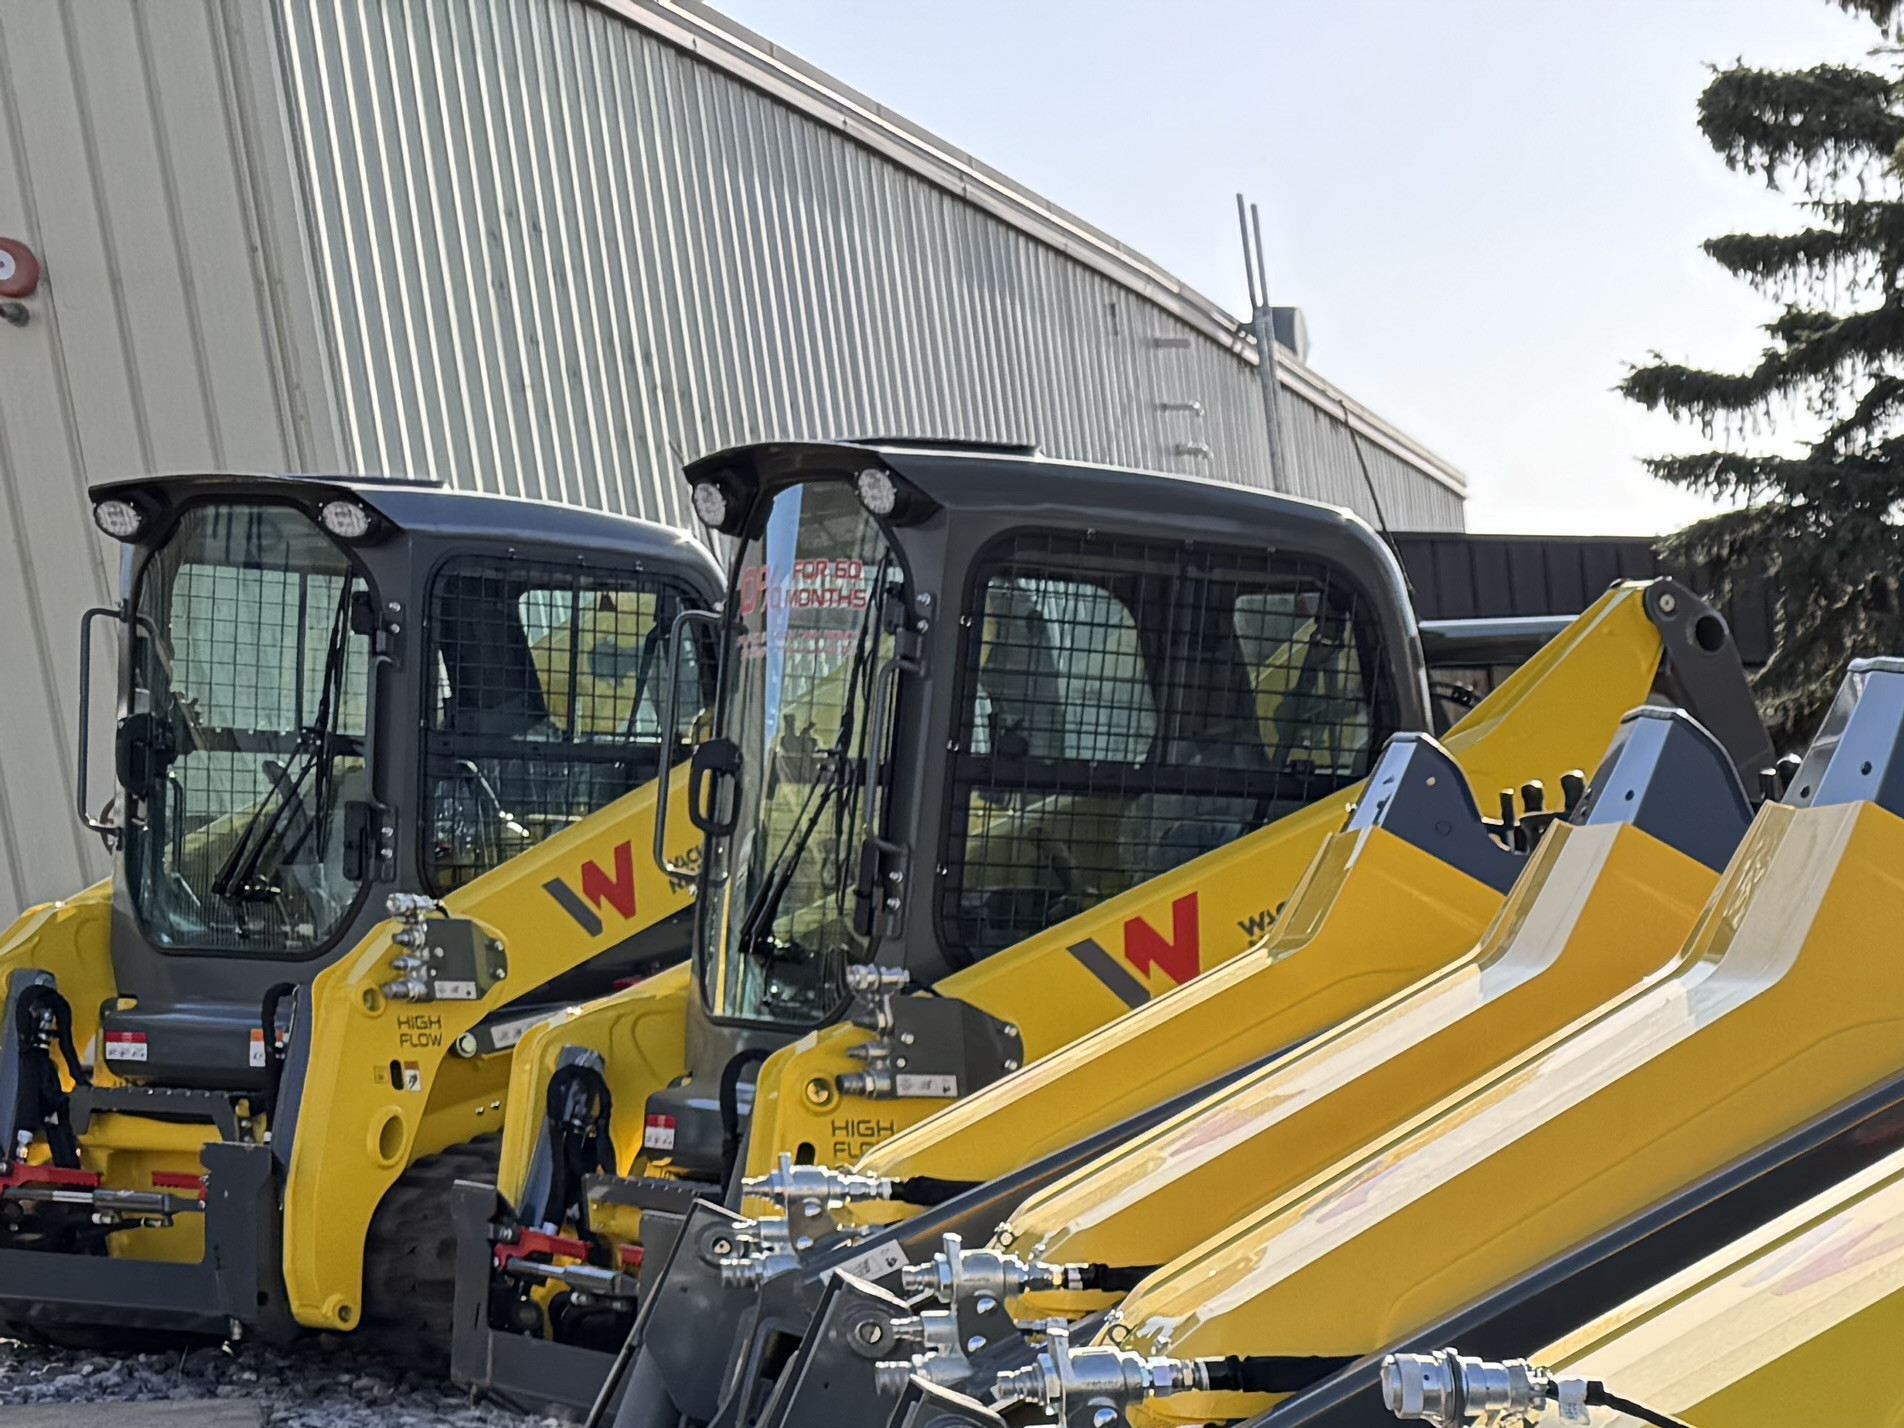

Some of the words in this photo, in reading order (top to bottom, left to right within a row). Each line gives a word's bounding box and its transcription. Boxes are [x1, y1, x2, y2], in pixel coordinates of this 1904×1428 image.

[793, 559, 829, 580] FOR
[788, 587, 868, 610] MONTHS
[397, 1015, 442, 1030] HIGH
[400, 1033, 442, 1048] FLOW
[831, 1120, 895, 1138] HIGH
[833, 1141, 880, 1159] FLO
